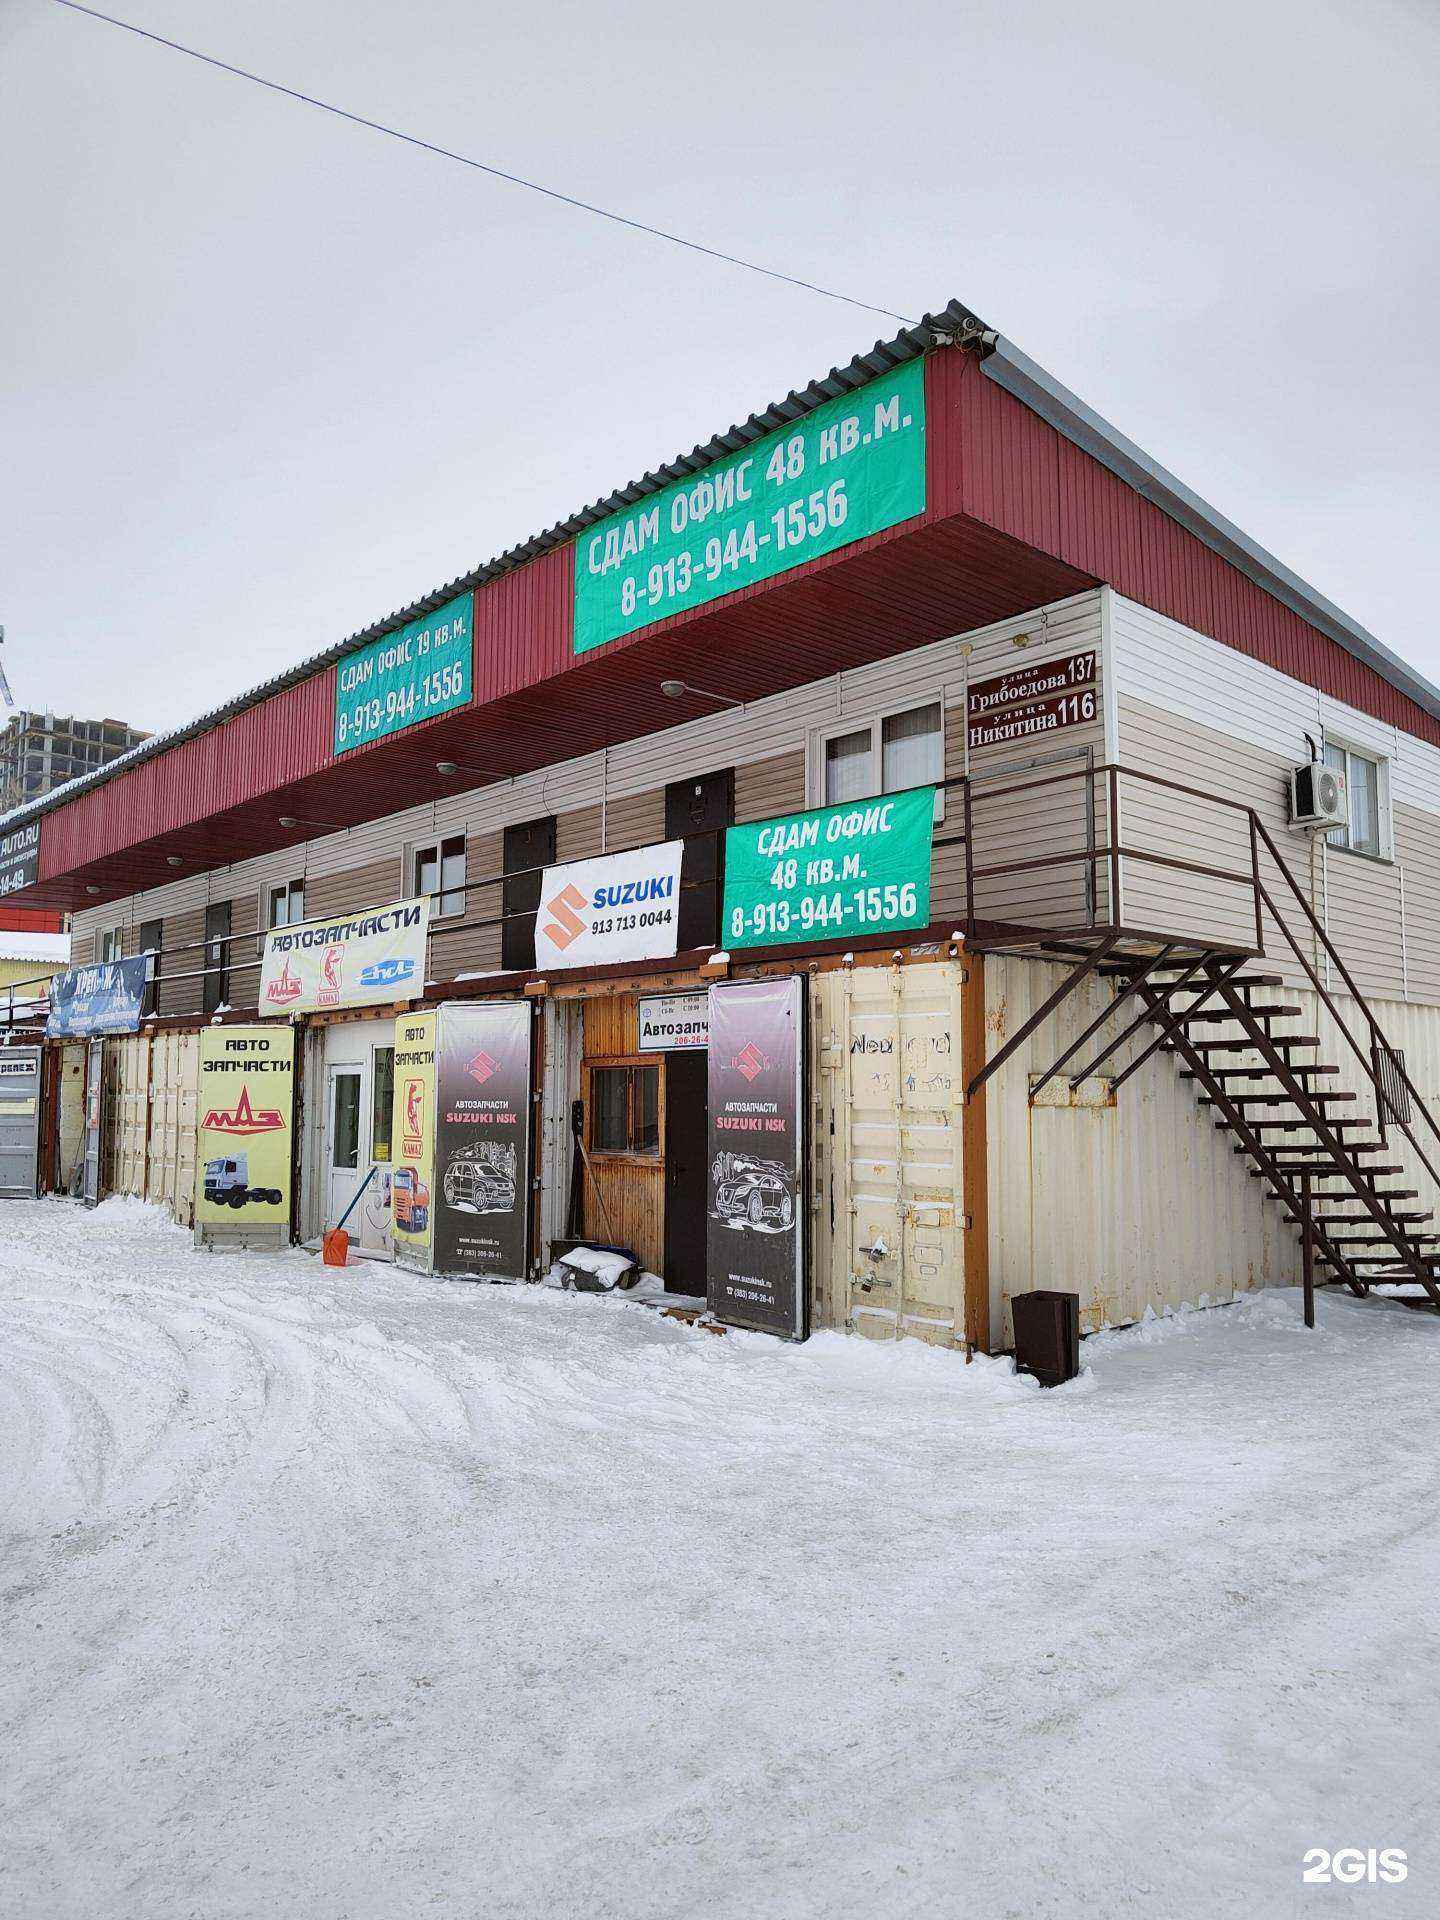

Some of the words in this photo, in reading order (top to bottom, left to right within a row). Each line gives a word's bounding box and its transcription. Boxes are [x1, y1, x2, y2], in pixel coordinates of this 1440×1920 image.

[588, 507, 660, 575] СДАМ
[670, 459, 754, 534] ОФИС
[765, 436, 805, 486] 48
[621, 479, 848, 616] 8-913-944-1556
[341, 657, 374, 693] СДАМ
[378, 638, 412, 674] ОФИС
[416, 630, 430, 656] 19
[969, 673, 1067, 711] Грибоедова
[1068, 653, 1095, 683] 137
[1001, 668, 1039, 686] улица
[338, 660, 463, 742] 8-913-944-1556
[994, 704, 1046, 724] улица
[969, 712, 1057, 747] Никитина
[1058, 692, 1094, 724] 116
[757, 819, 820, 857] СДАМ
[826, 803, 894, 838] ОФИС
[770, 859, 798, 891] 48
[592, 875, 673, 909] SUZUKI
[592, 919, 613, 935] 913
[617, 914, 636, 931] 713
[640, 909, 672, 927] 0044
[731, 883, 917, 938] 8-913-944-1556
[272, 905, 421, 953] АВТОЗАПЧАСТИ
[404, 1027, 425, 1041] АВТО
[643, 1021, 708, 1036] Автозапч
[225, 1040, 270, 1051] АВТО
[395, 1051, 434, 1066] ЗАПЧАСТИ
[203, 1060, 292, 1072] ЗАПЧАСТИ
[455, 1100, 509, 1109] АВТОЗАПЧАСТИ
[724, 1102, 778, 1113] АВТОЗАПЧАСТИ
[446, 1112, 493, 1123] SUZUKI
[496, 1113, 517, 1124] NSK
[716, 1116, 762, 1131] SUZUKI
[765, 1118, 786, 1132] NSK
